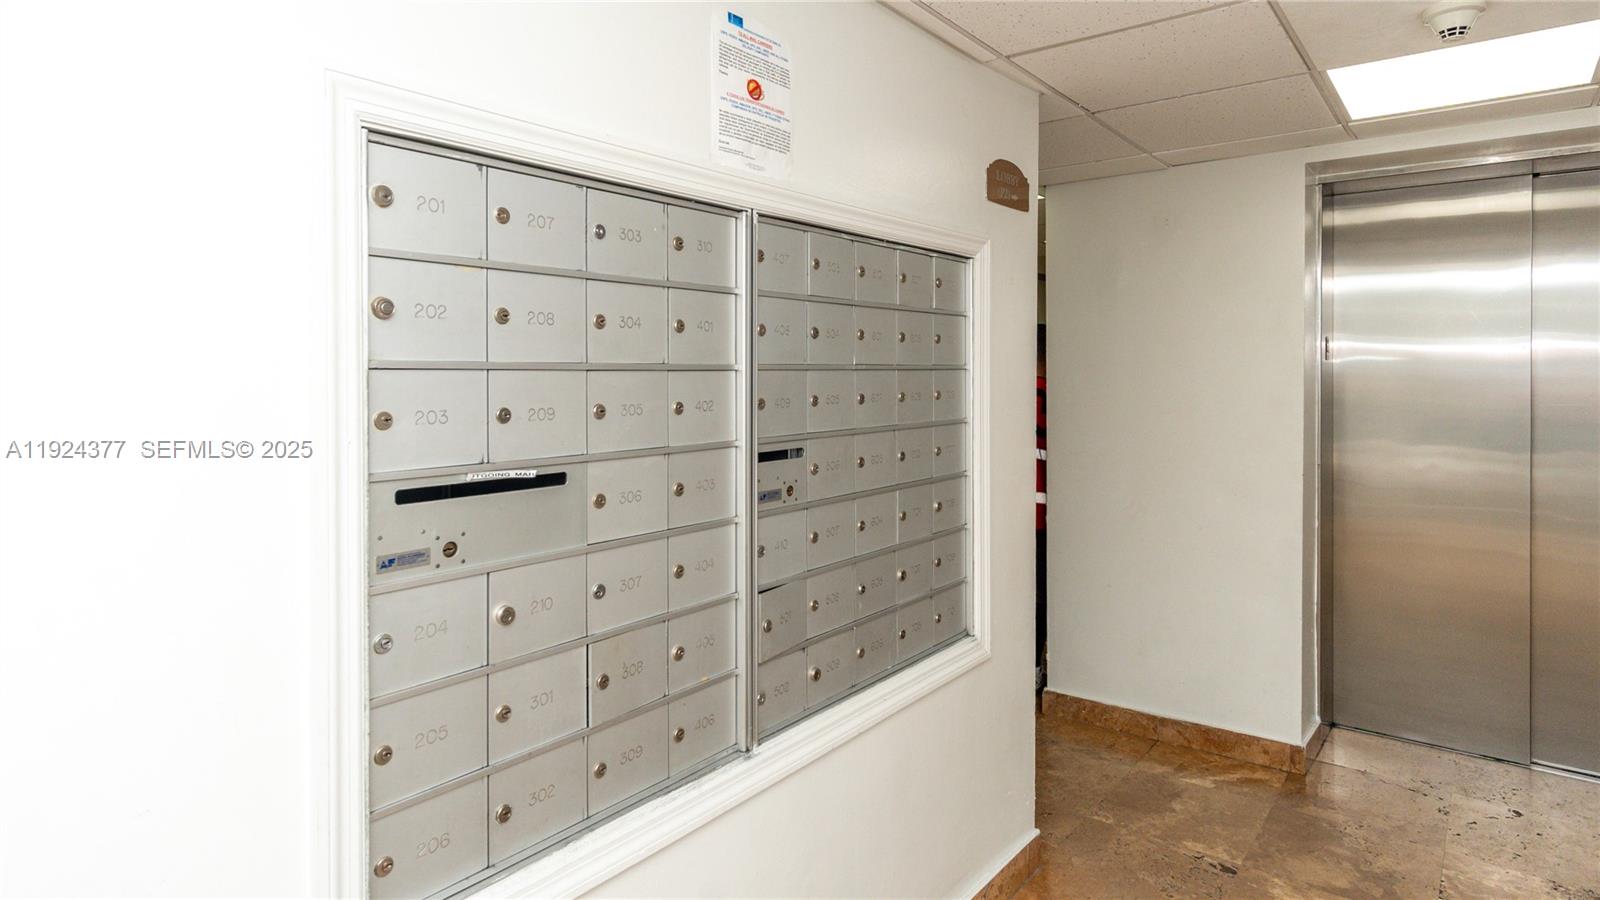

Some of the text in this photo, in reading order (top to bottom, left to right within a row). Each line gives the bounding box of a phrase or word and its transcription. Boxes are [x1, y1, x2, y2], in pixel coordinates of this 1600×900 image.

[415, 194, 447, 214] 201
[526, 212, 555, 230] 207
[618, 227, 642, 243] 303
[696, 239, 713, 253] 310
[773, 252, 790, 264] 407
[414, 302, 447, 320] 202
[527, 310, 555, 327] 208
[617, 315, 643, 330] 304
[696, 319, 714, 333] 401
[527, 406, 556, 422] 209
[620, 403, 644, 417] 305
[694, 399, 714, 413] 402
[414, 409, 449, 426] 203
[695, 478, 716, 492] 403
[618, 489, 642, 505] 306
[694, 557, 715, 572] 404
[619, 575, 642, 593] 307
[530, 596, 554, 615] 210
[413, 619, 448, 641] 204
[620, 661, 645, 680] 308
[530, 690, 554, 710] 301
[694, 713, 715, 730] 406
[414, 724, 449, 749] 205
[619, 744, 644, 766] 309
[528, 783, 556, 807] 302
[415, 832, 451, 859] 206
